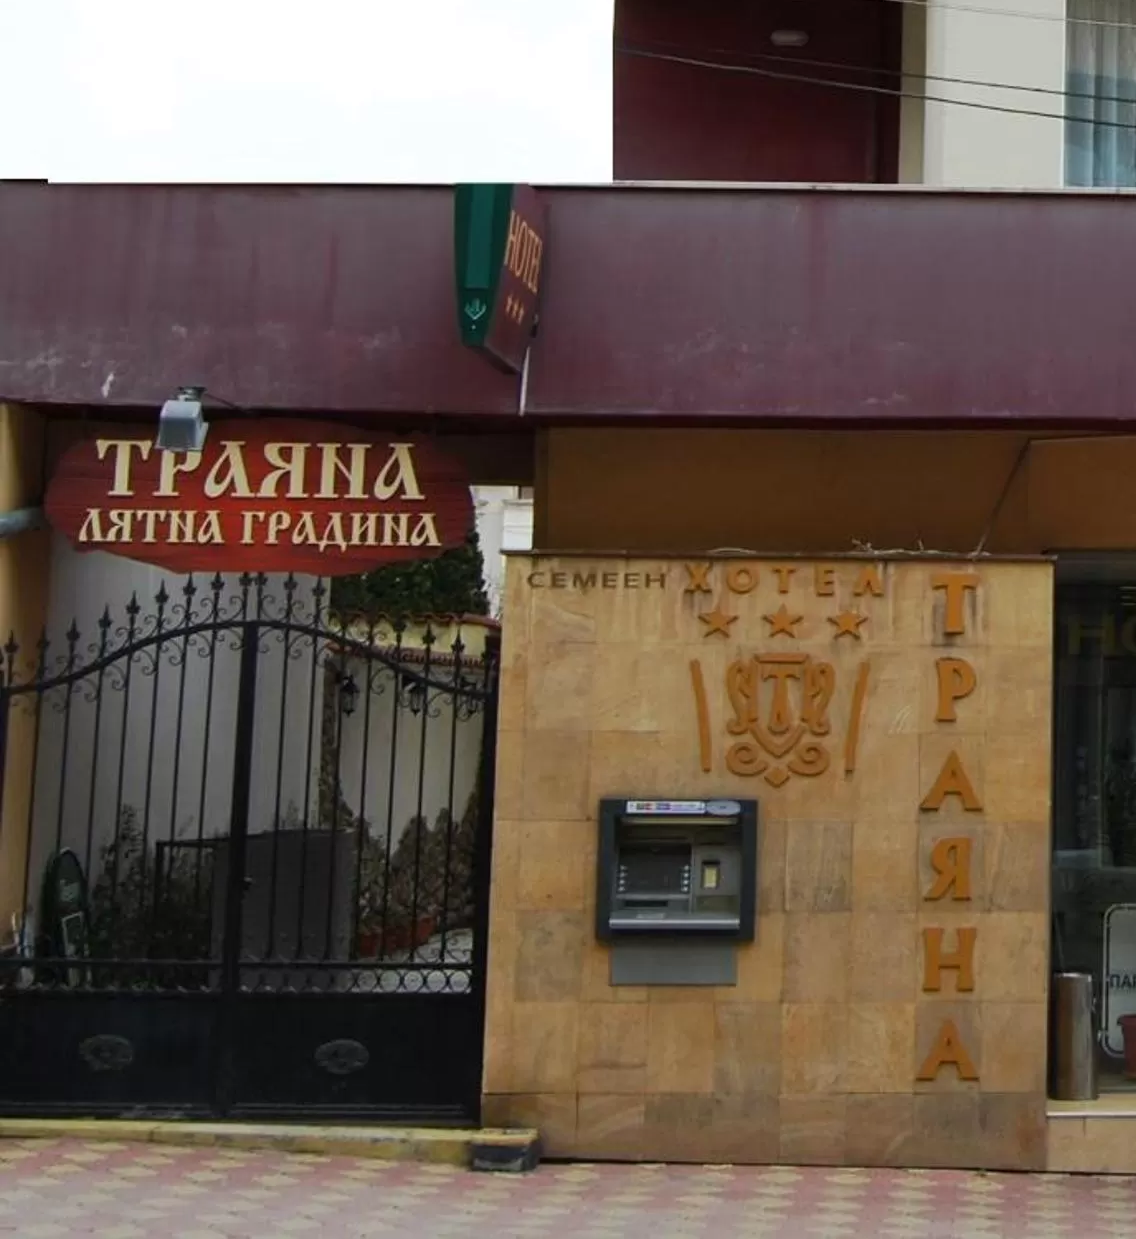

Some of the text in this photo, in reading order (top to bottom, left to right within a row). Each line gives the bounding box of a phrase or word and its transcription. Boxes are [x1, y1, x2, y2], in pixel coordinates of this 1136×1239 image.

[504, 209, 543, 294] HOTEL
[96, 439, 426, 500] ТРАЯНА
[79, 509, 442, 552] ЛЯТНА ГРАДИНА
[527, 562, 885, 598] СЕМЕЕН ХОТЕЛ
[915, 573, 983, 1080] ТРАЯНА
